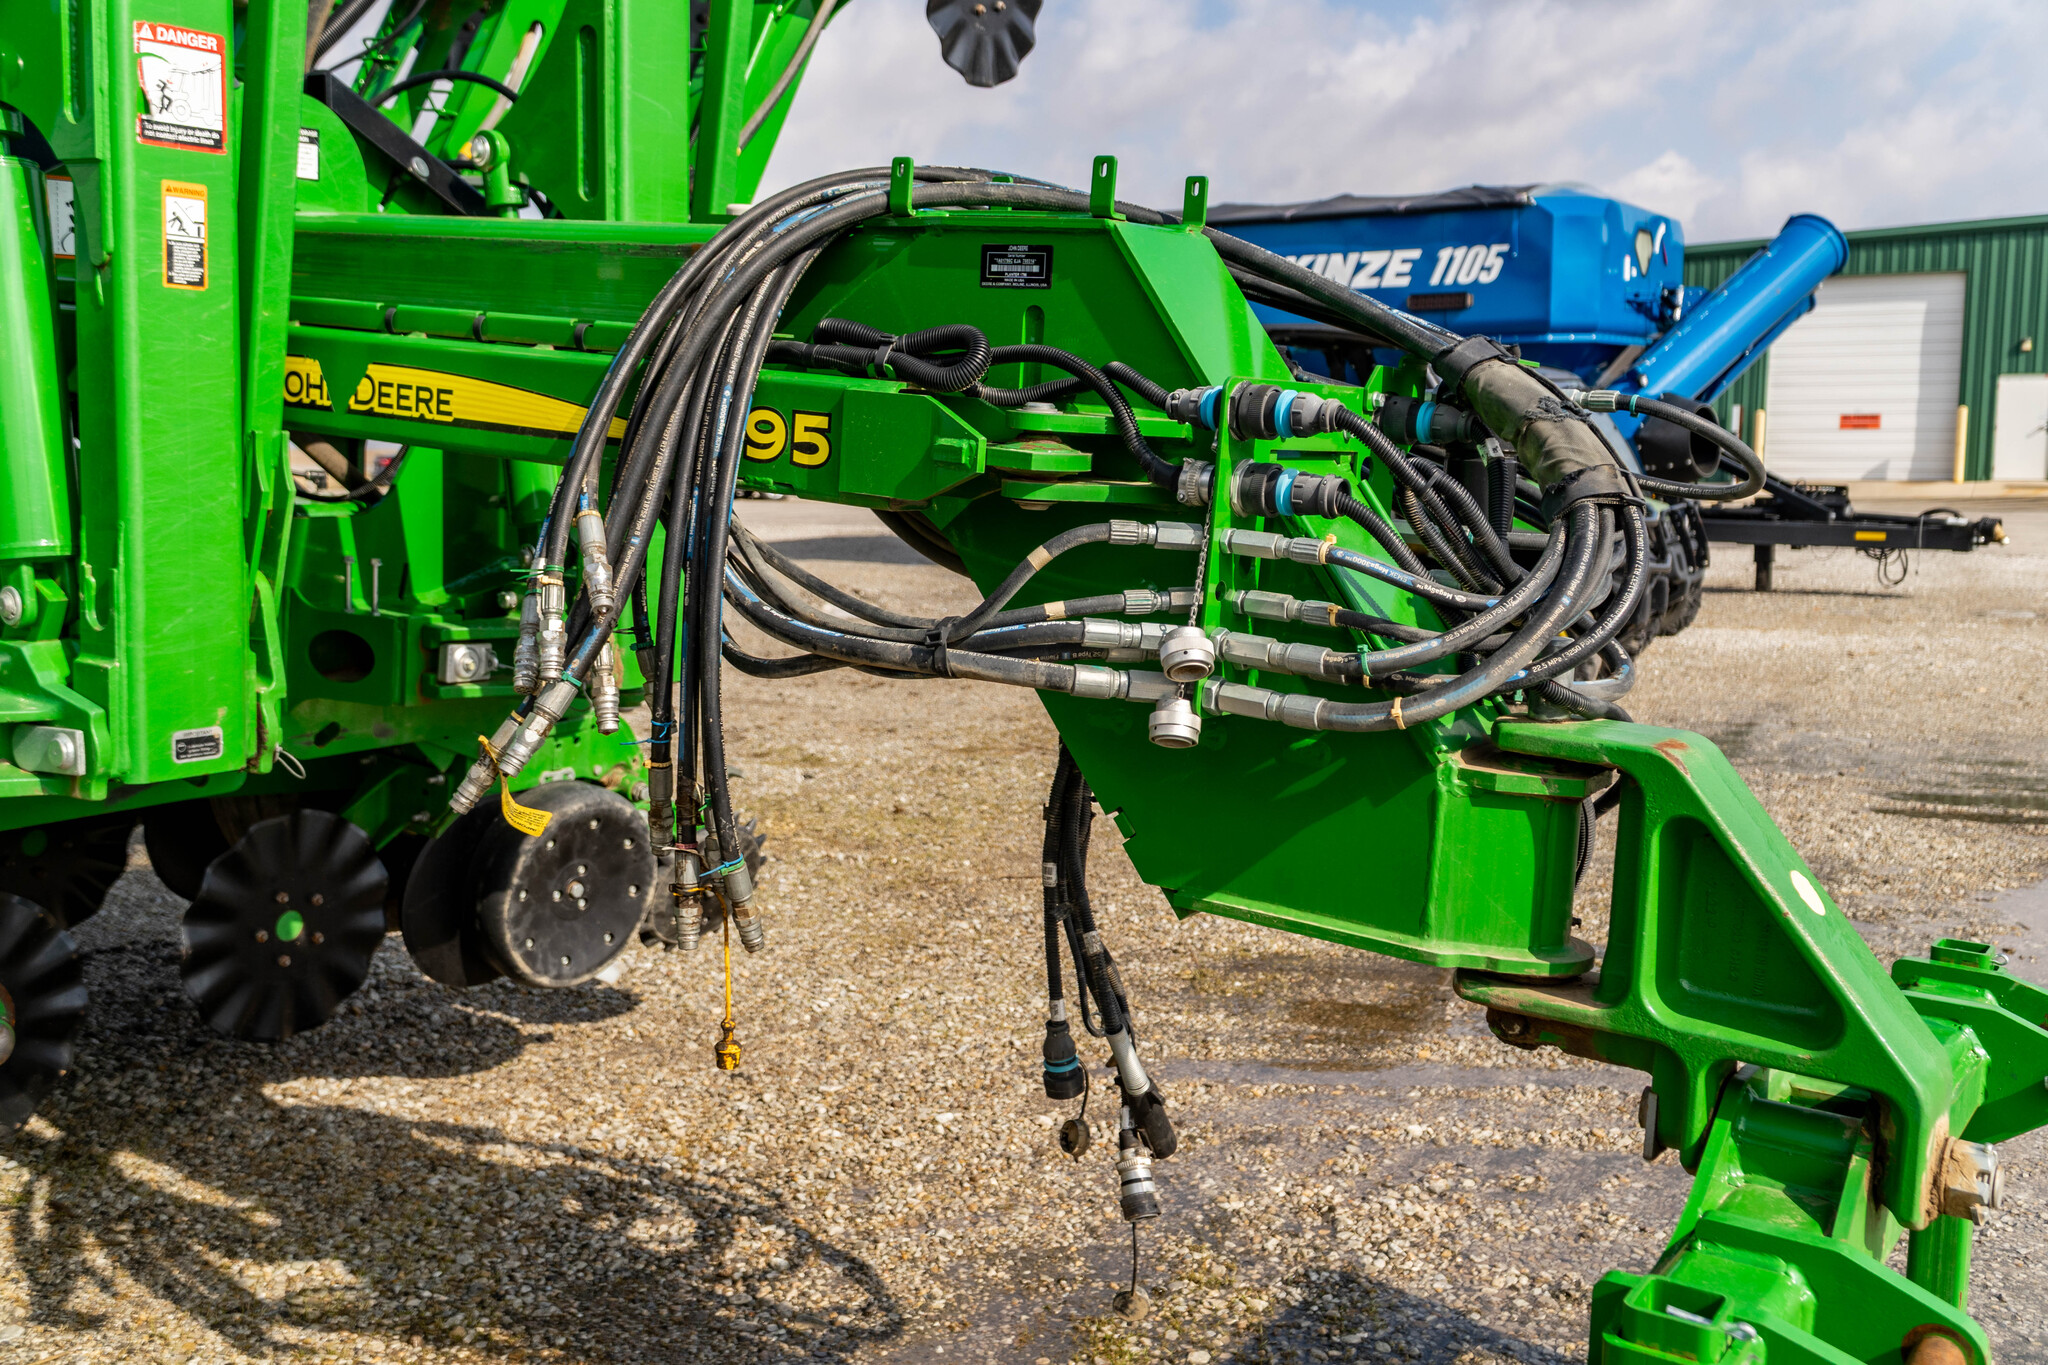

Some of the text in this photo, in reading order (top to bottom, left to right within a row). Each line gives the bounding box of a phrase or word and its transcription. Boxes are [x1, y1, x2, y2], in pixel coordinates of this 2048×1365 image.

[156, 26, 218, 51] DANGER
[172, 186, 204, 197] WARNING
[1428, 243, 1511, 286] 1105
[727, 369, 736, 383] 22.5
[285, 371, 453, 417] OH DEERE
[635, 518, 645, 531] Type
[624, 545, 636, 563] Flame
[1345, 555, 1389, 575] Mega3000™
[613, 563, 630, 588] Resistant
[1416, 584, 1453, 600] MegaSys™
[1549, 604, 1565, 622] Flame
[1444, 631, 1460, 642] 22.5
[1460, 624, 1475, 635] MPa
[1530, 621, 1552, 645] Resistant
[1513, 643, 1530, 659] MSHA
[1532, 663, 1548, 673] 22.5
[1547, 656, 1562, 667] MPa
[183, 729, 213, 737] IMPORTANT
